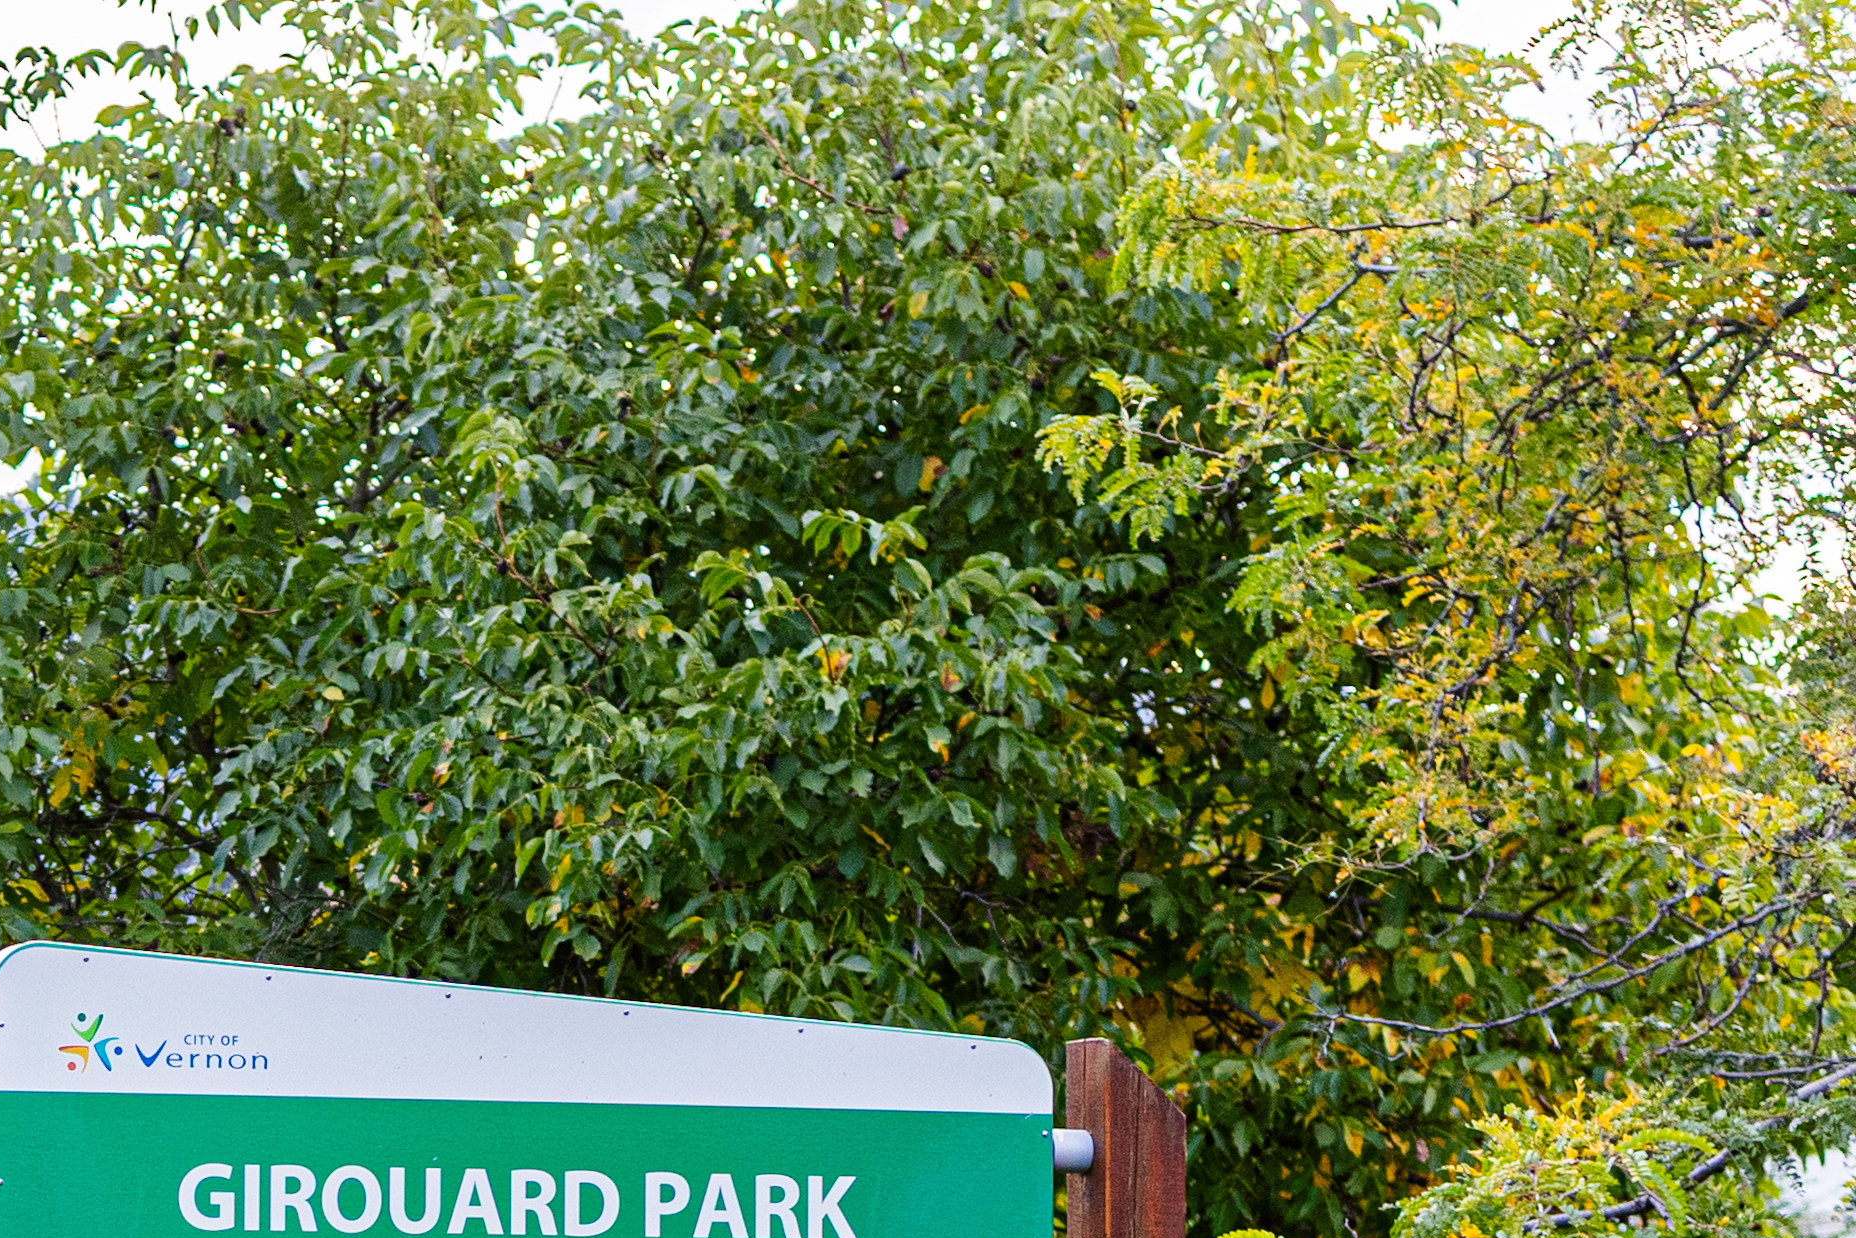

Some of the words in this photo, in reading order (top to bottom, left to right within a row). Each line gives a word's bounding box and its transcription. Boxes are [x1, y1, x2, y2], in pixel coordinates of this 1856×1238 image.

[135, 1040, 268, 1070] Vernon
[183, 1034, 215, 1046] CITY
[220, 1035, 239, 1046] OF
[177, 1162, 621, 1238] GIROUARD
